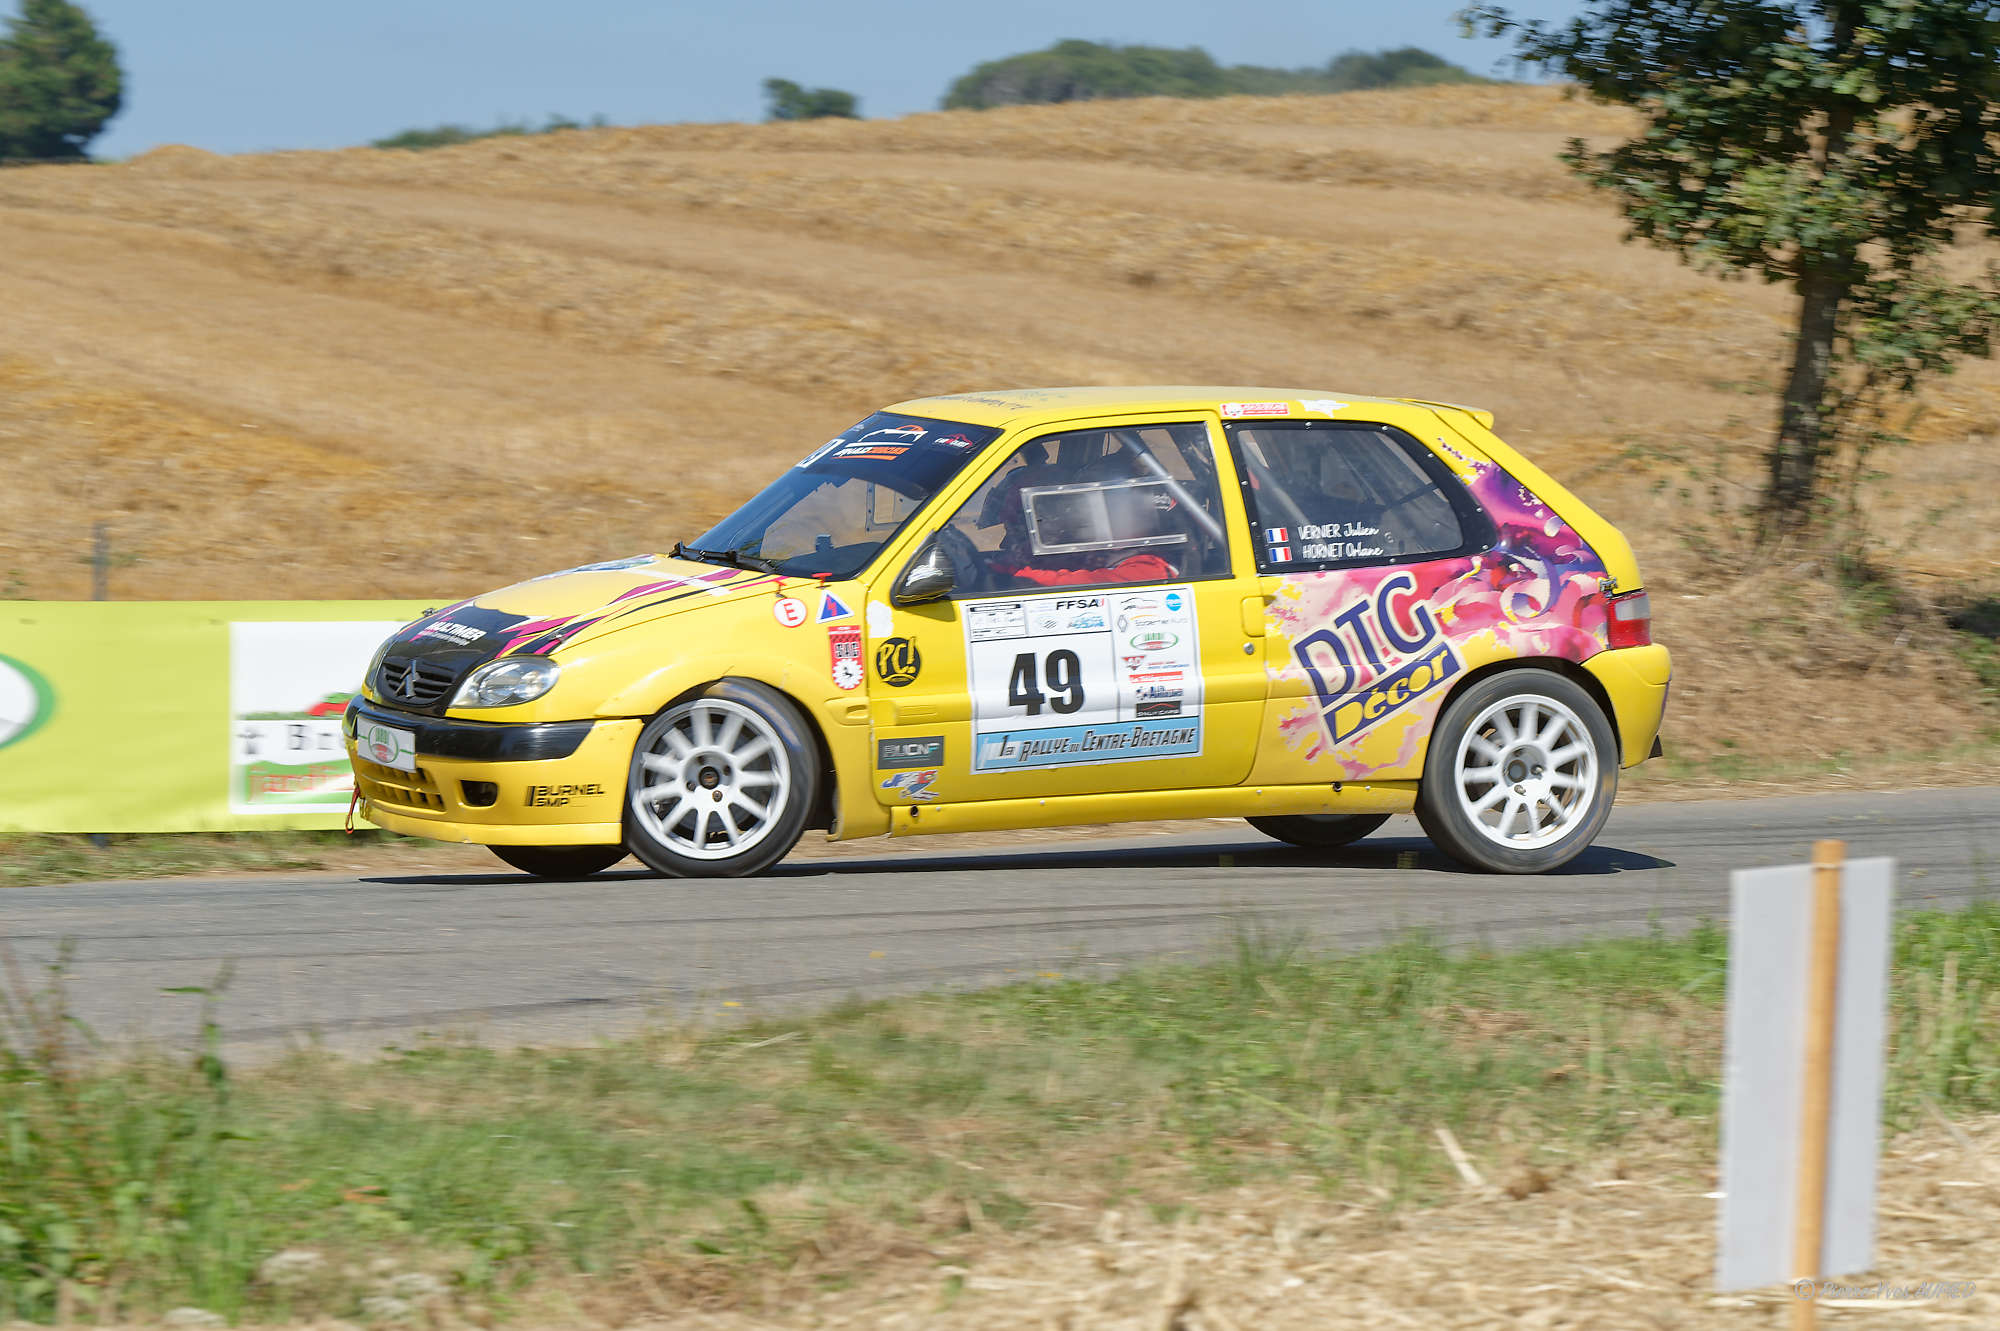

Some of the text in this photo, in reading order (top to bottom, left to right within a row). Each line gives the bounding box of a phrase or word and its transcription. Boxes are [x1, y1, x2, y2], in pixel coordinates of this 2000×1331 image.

[1298, 521, 1379, 540] VERNIER Julien
[1303, 543, 1345, 559] HORNET
[783, 602, 798, 621] E
[1056, 599, 1099, 611] FFSA
[1294, 576, 1437, 708] DTG
[1009, 649, 1084, 716] 49
[1019, 738, 1072, 762] RALLYE
[1080, 726, 1196, 752] CENTRE-BRETAGNE
[536, 784, 604, 796] BURNEL
[535, 797, 569, 808] SMP
